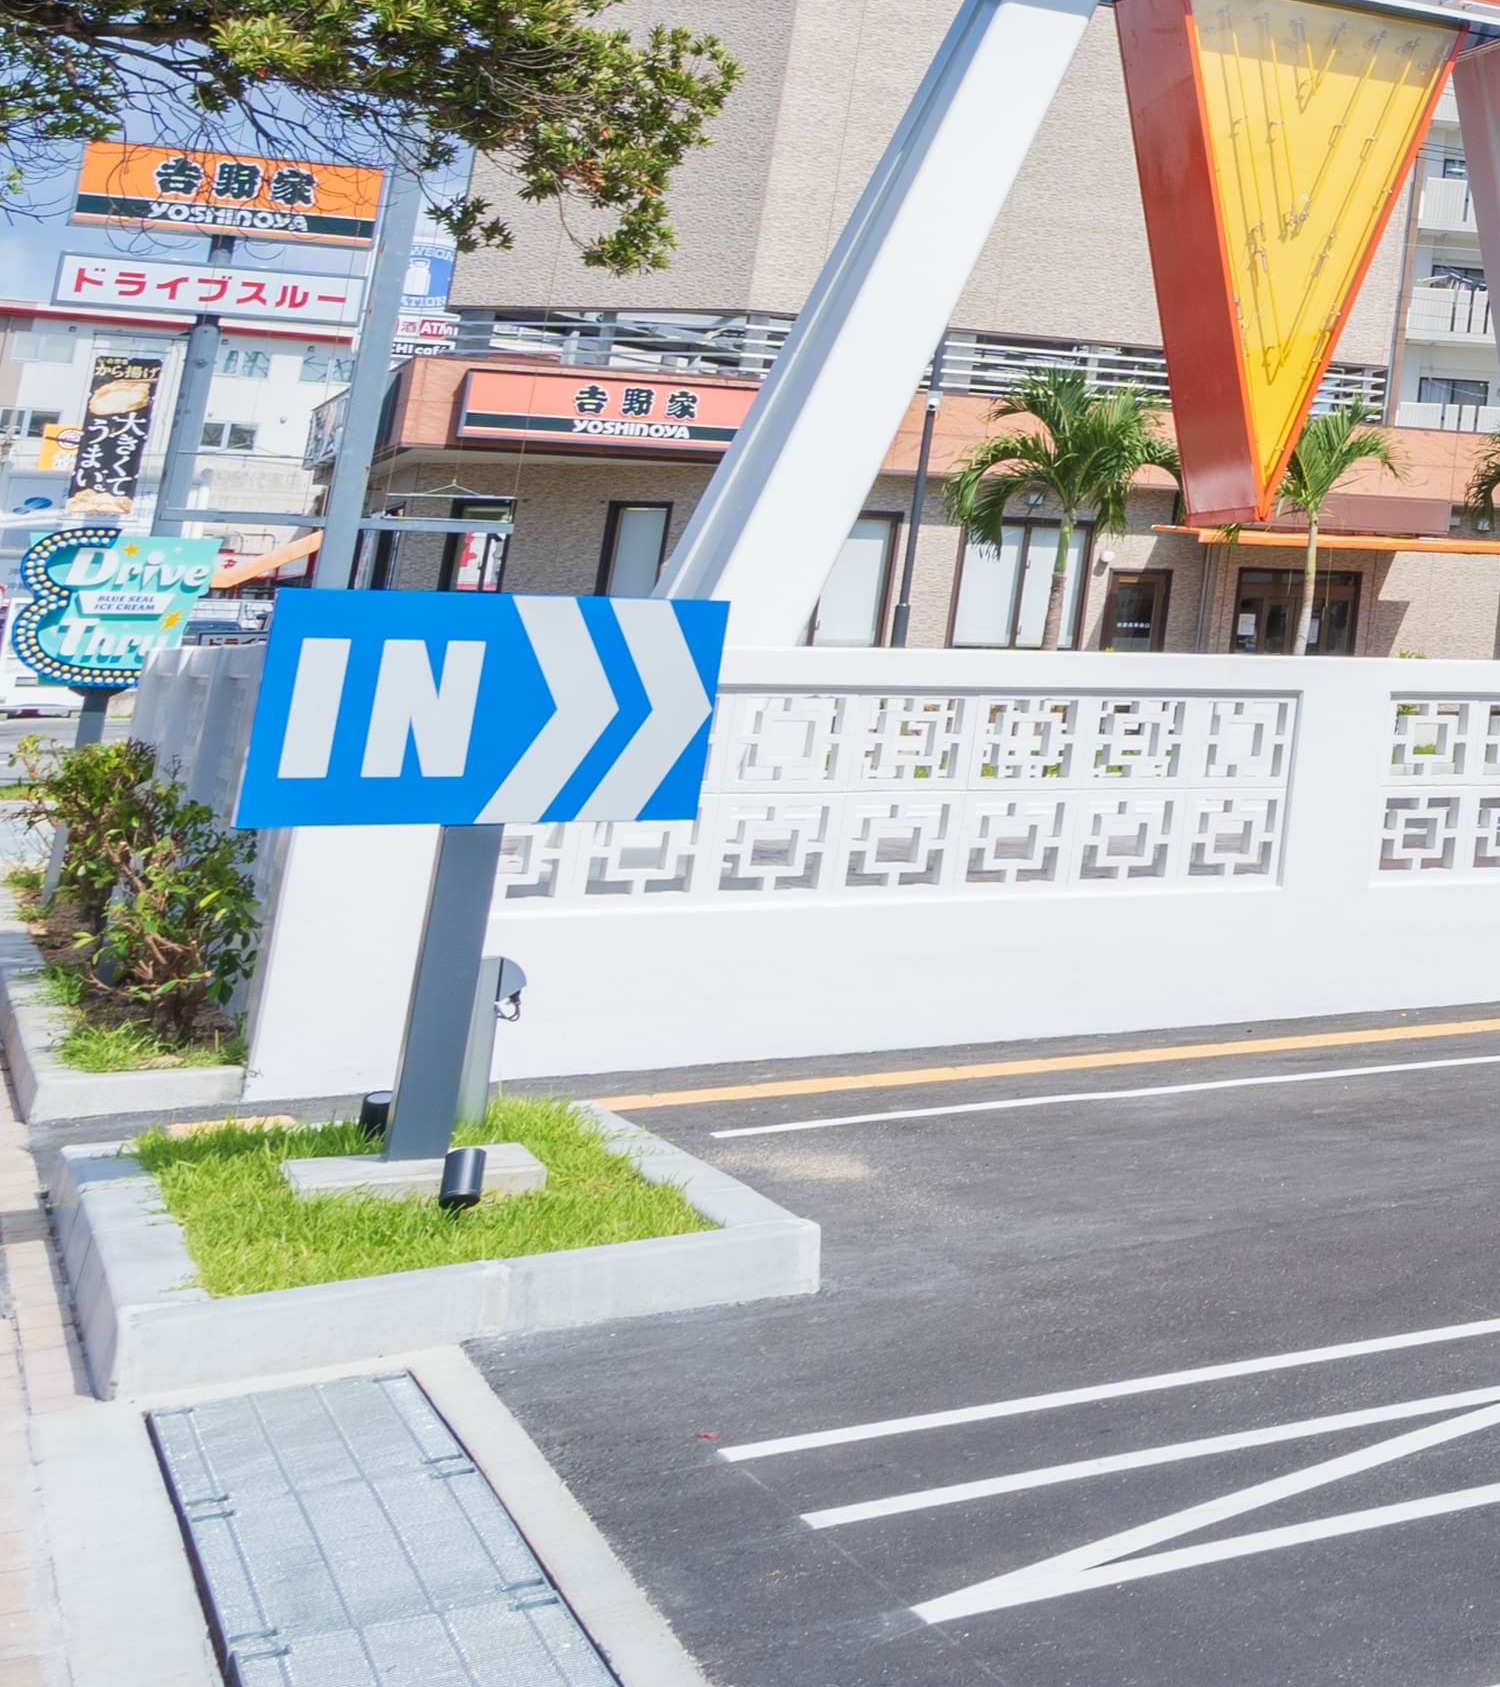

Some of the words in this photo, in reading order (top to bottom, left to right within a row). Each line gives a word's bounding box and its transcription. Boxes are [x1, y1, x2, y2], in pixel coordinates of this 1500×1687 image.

[155, 156, 317, 206] 吉野家
[73, 267, 347, 309] ドライブスルー
[401, 296, 447, 308] ATION
[575, 385, 698, 419] 吉野家
[572, 418, 690, 439] YOSHINOYA
[106, 412, 147, 496] 大きくて
[64, 547, 209, 587] Drive
[94, 603, 113, 611] ICE
[116, 603, 155, 611] CREAM
[98, 595, 126, 603] BLUE
[129, 595, 155, 603] SEAL
[279, 639, 484, 777] IN
